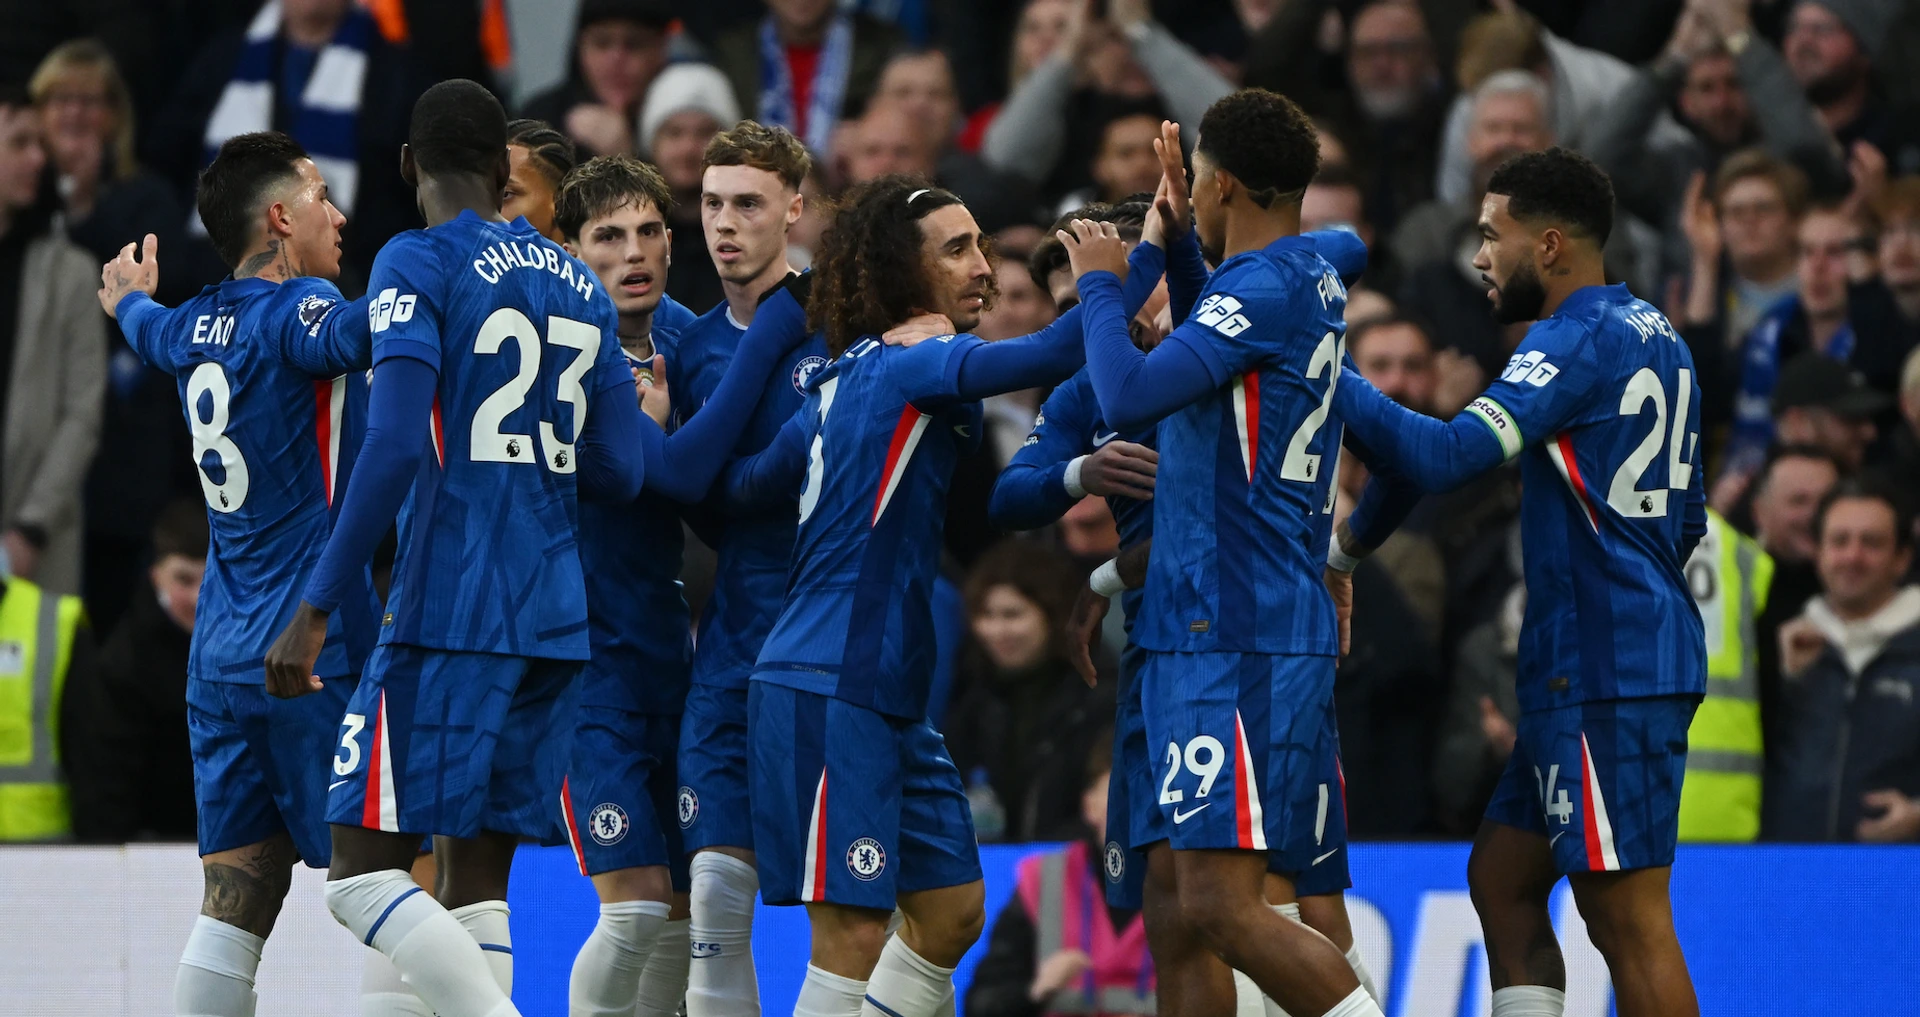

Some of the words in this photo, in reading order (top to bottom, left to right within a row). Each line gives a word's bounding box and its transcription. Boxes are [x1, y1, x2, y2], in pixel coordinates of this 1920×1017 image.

[473, 241, 594, 301] CHALOBAH
[1625, 311, 1676, 344] JAMES
[187, 362, 249, 514] 8
[470, 307, 601, 474] 23
[1607, 367, 1698, 518] 24
[1159, 735, 1225, 805] 29
